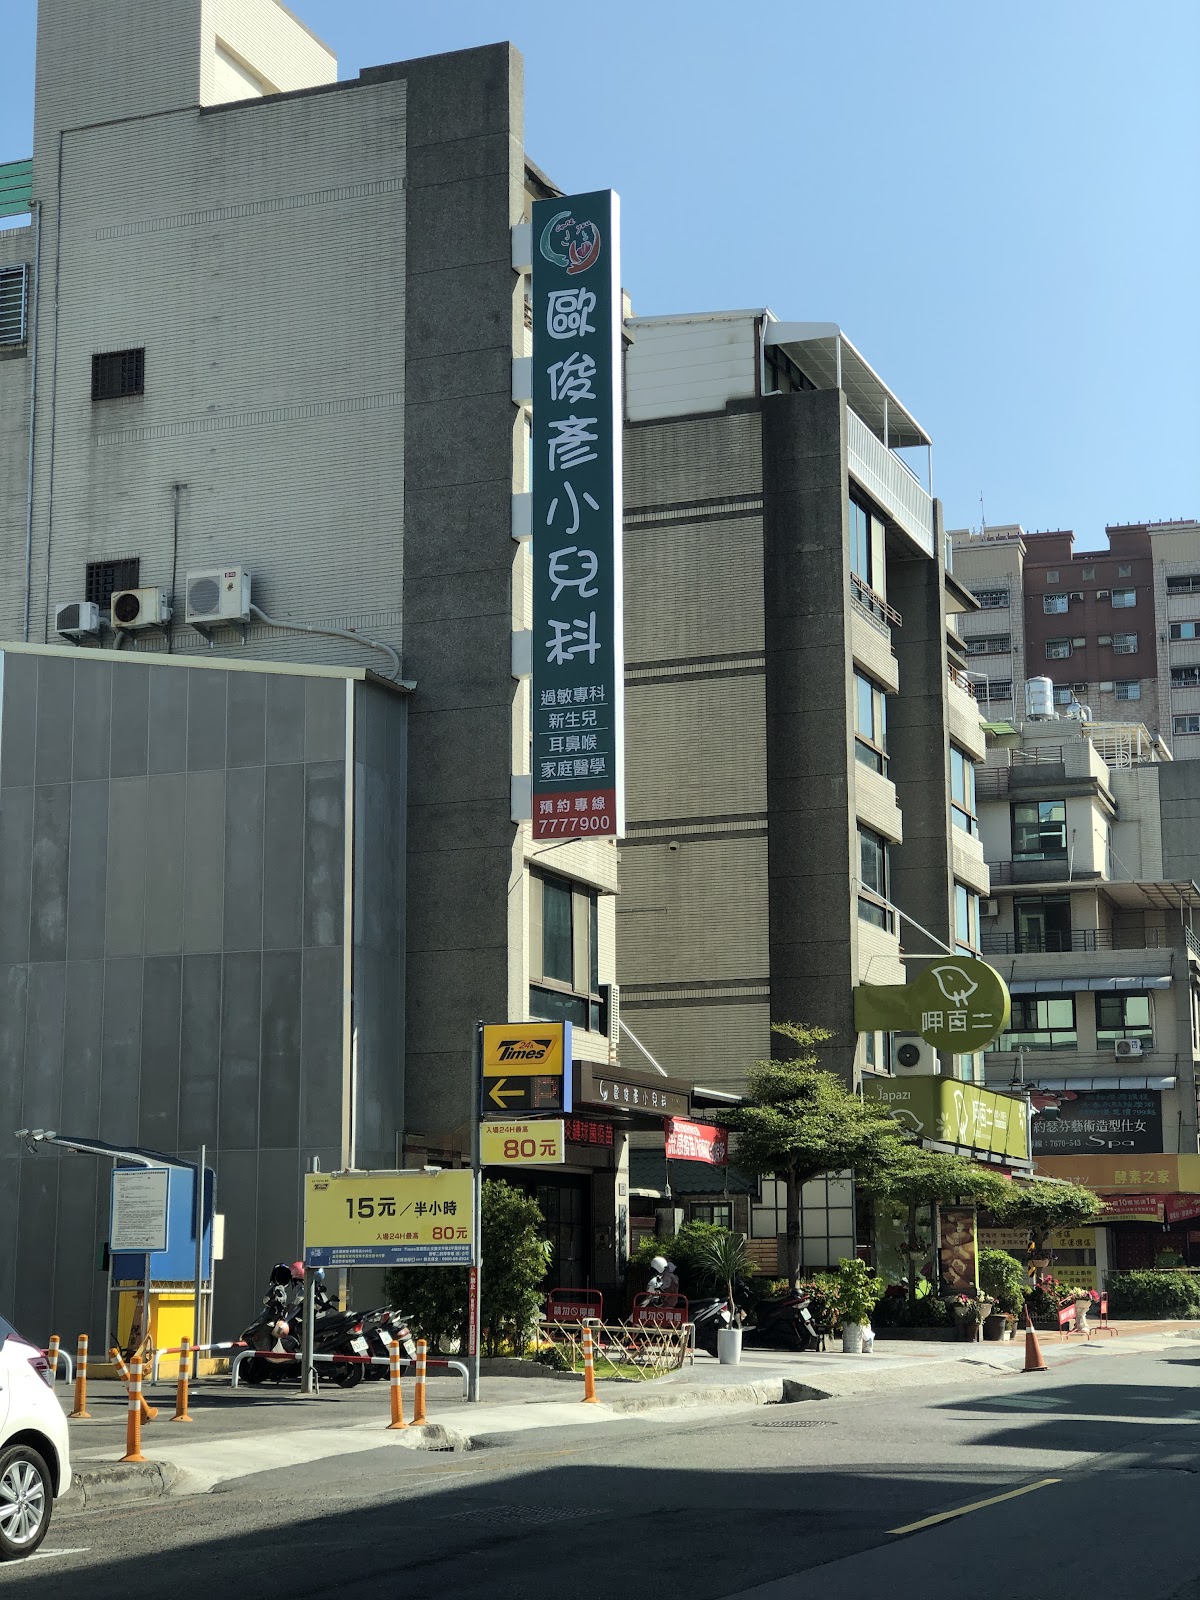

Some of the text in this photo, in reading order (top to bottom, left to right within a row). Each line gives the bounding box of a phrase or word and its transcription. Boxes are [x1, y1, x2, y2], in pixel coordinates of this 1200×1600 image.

[541, 685, 605, 706] 過敏專科
[548, 709, 598, 729] 新生兒
[549, 734, 598, 753] 耳鼻喉
[541, 757, 606, 778] 家庭醫學
[539, 796, 606, 815] 預約專線
[538, 815, 610, 834] 7777900
[922, 1009, 993, 1034] 呷百二
[498, 1040, 550, 1061] Times
[503, 1139, 556, 1159] 80元
[1085, 1134, 1135, 1149] Spa
[1114, 1169, 1170, 1184] 酵素之家
[432, 1226, 468, 1241] 80元
